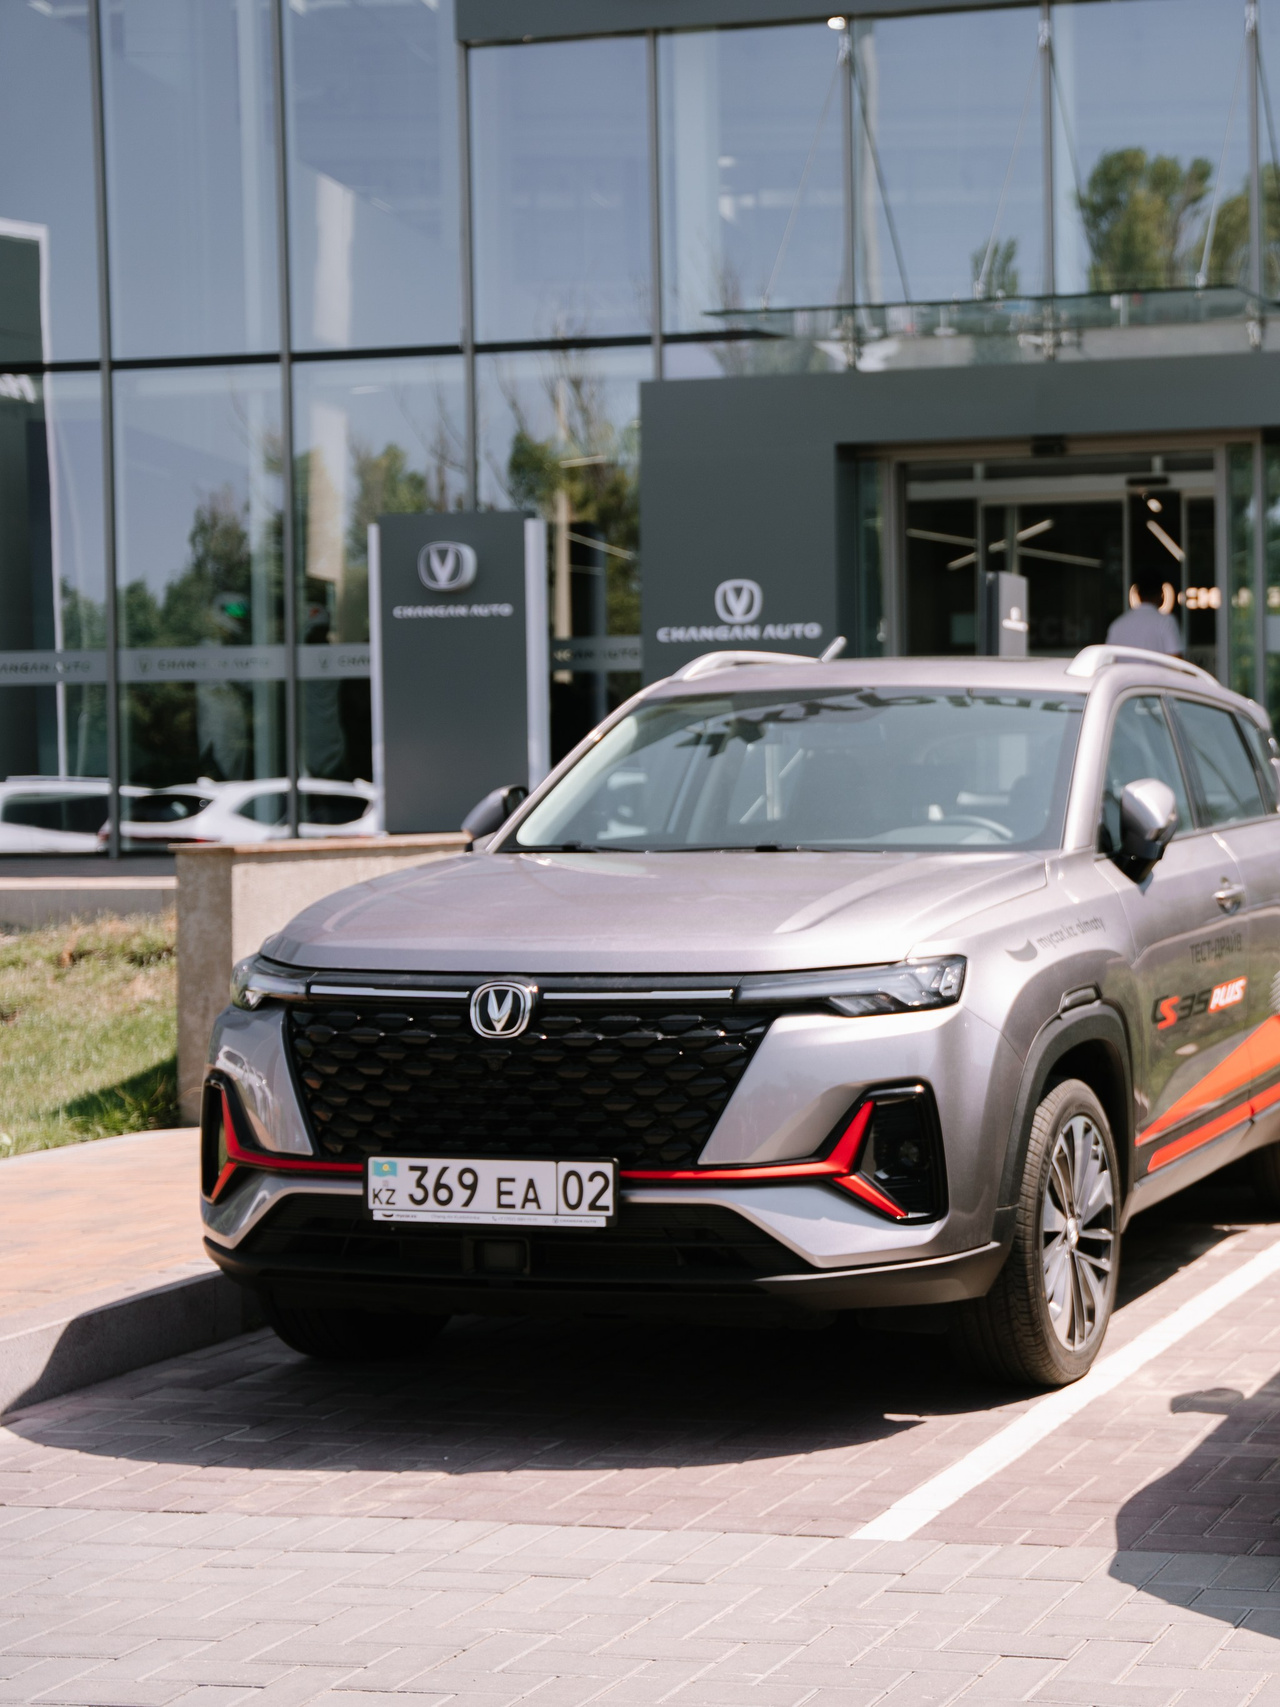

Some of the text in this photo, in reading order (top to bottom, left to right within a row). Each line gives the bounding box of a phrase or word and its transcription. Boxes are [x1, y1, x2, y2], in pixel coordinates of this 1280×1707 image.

[656, 621, 823, 643] CHANGAN AUTO
[373, 1166, 610, 1212] KZ 369 EA 02
